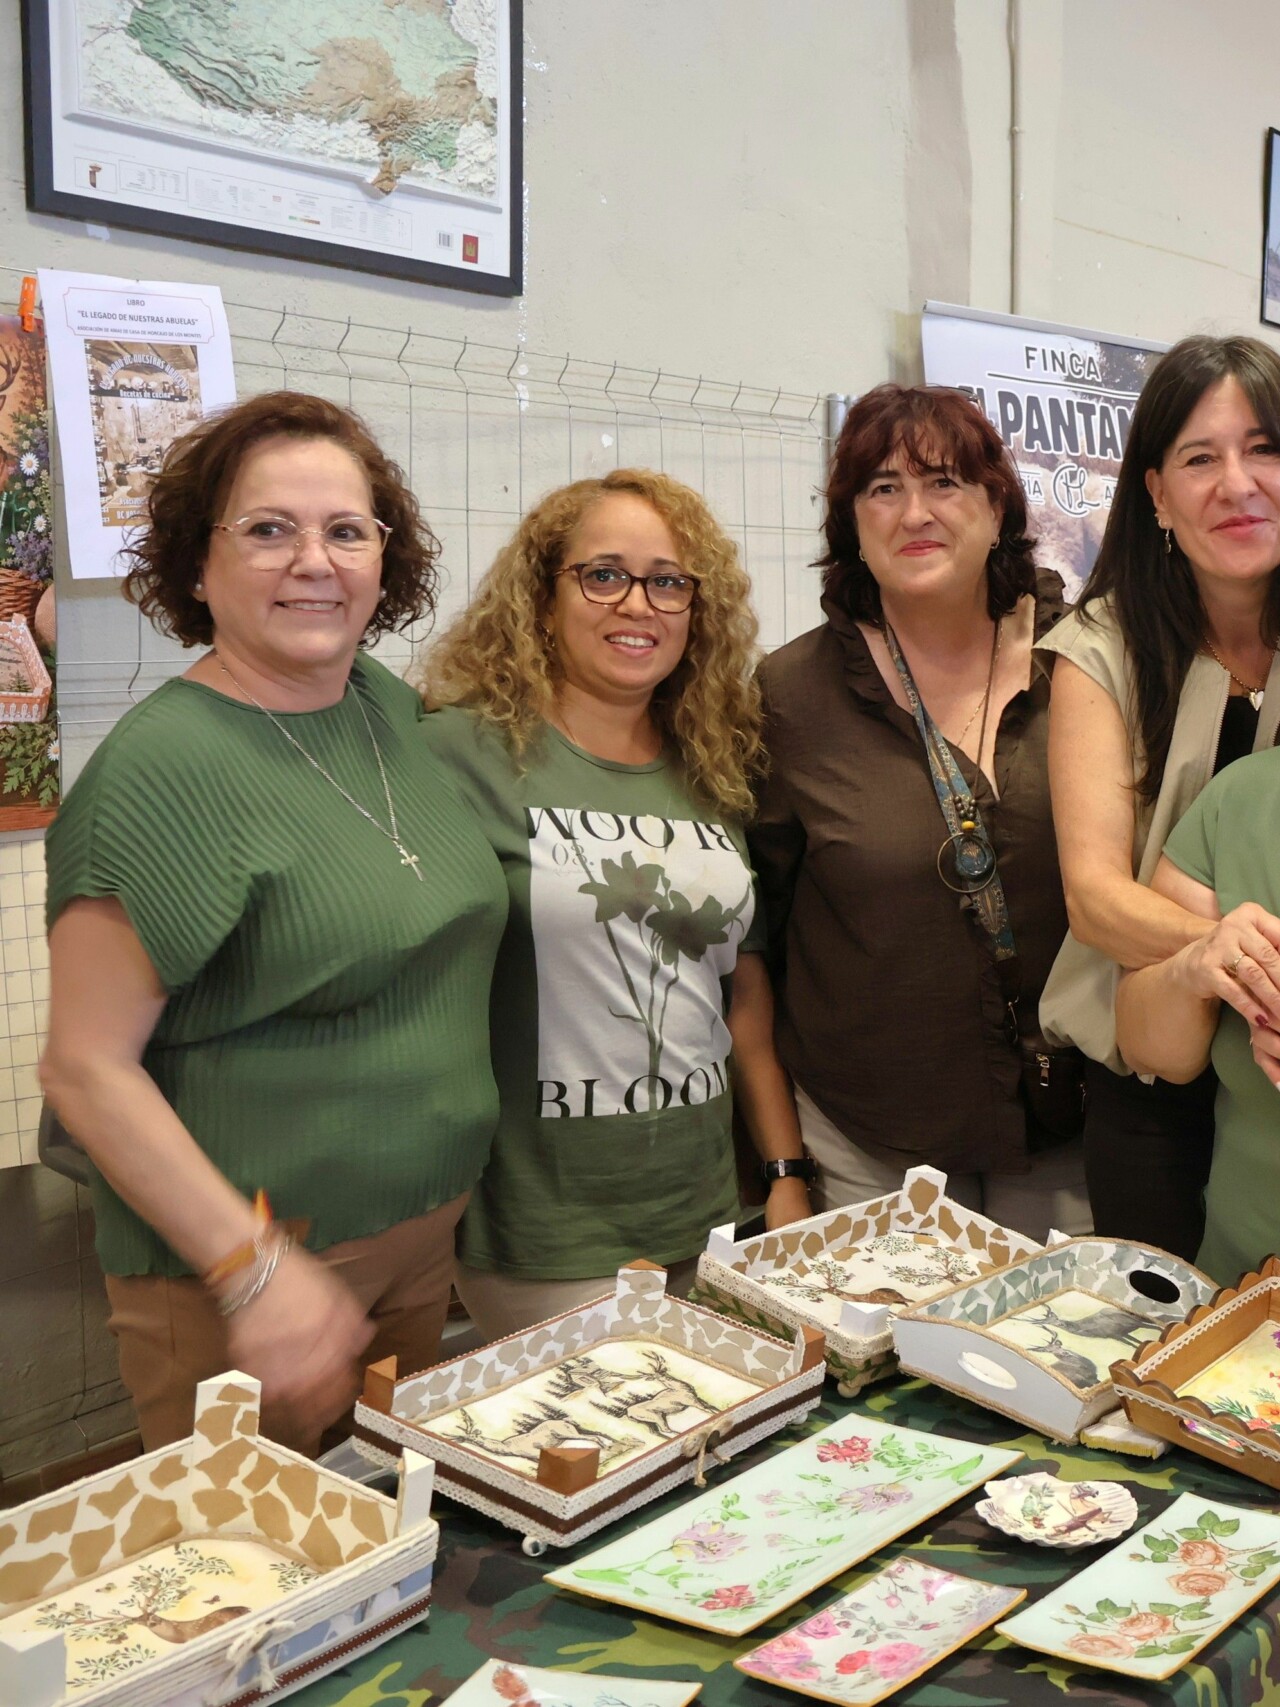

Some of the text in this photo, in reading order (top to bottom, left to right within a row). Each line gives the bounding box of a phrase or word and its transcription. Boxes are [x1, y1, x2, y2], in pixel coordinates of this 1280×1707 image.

[126, 298, 146, 307] LIBRO
[90, 311, 117, 320] LEGADO
[118, 313, 128, 321] DE
[128, 315, 164, 324] NUESTRAS
[1025, 346, 1102, 382] FINCA
